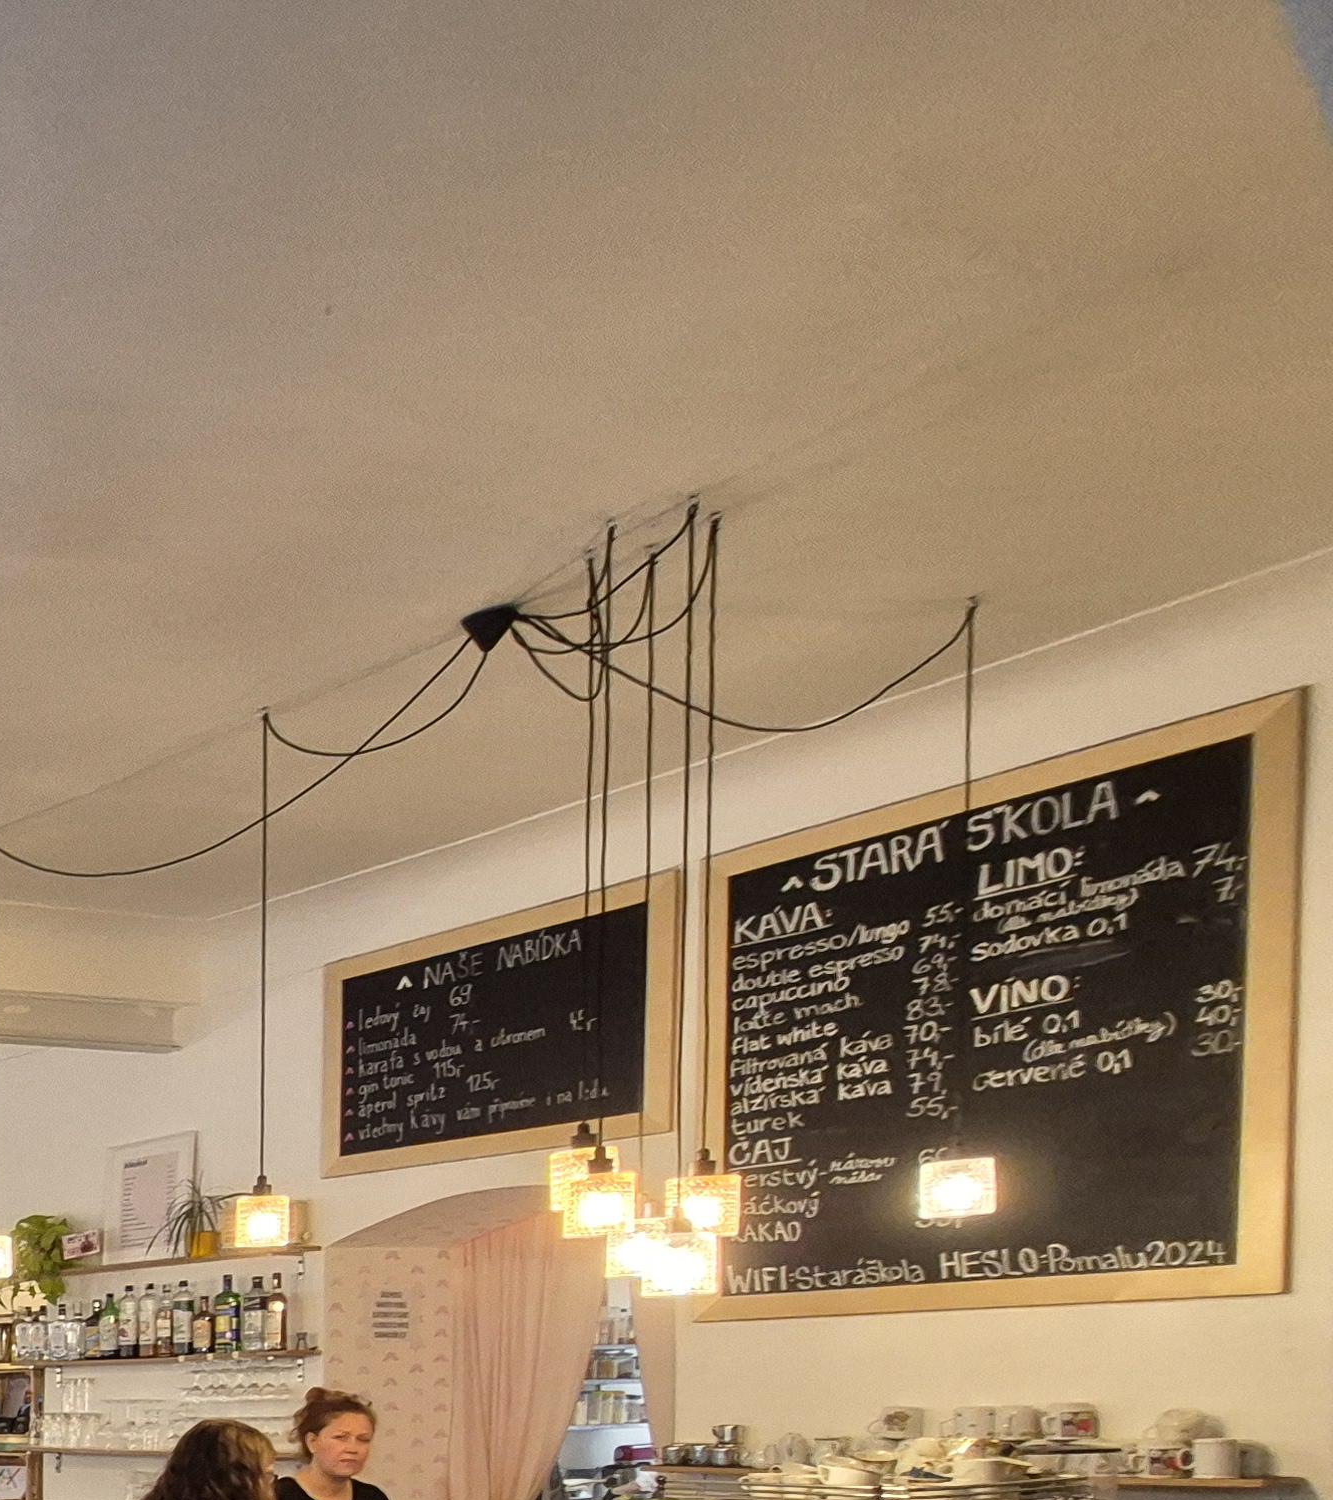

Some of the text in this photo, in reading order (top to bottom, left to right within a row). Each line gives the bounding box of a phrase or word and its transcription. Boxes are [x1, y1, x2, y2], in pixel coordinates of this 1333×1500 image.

[810, 821, 949, 891] STARÁ
[978, 846, 1086, 896] LIMO:
[423, 929, 582, 989] NAŠE NABÍDKA
[731, 968, 801, 993] double
[808, 946, 905, 981] espresso
[731, 976, 850, 1014] capuccino
[358, 1027, 417, 1056] limonáda
[731, 1034, 773, 1056] flat
[776, 1020, 839, 1047] white
[839, 1029, 894, 1058] káva
[358, 1051, 404, 1078] karafa
[475, 1039, 483, 1052] a
[837, 1055, 889, 1082] káva
[836, 1077, 893, 1101] káva
[731, 1111, 806, 1138] turek
[744, 1191, 821, 1219] áčkový
